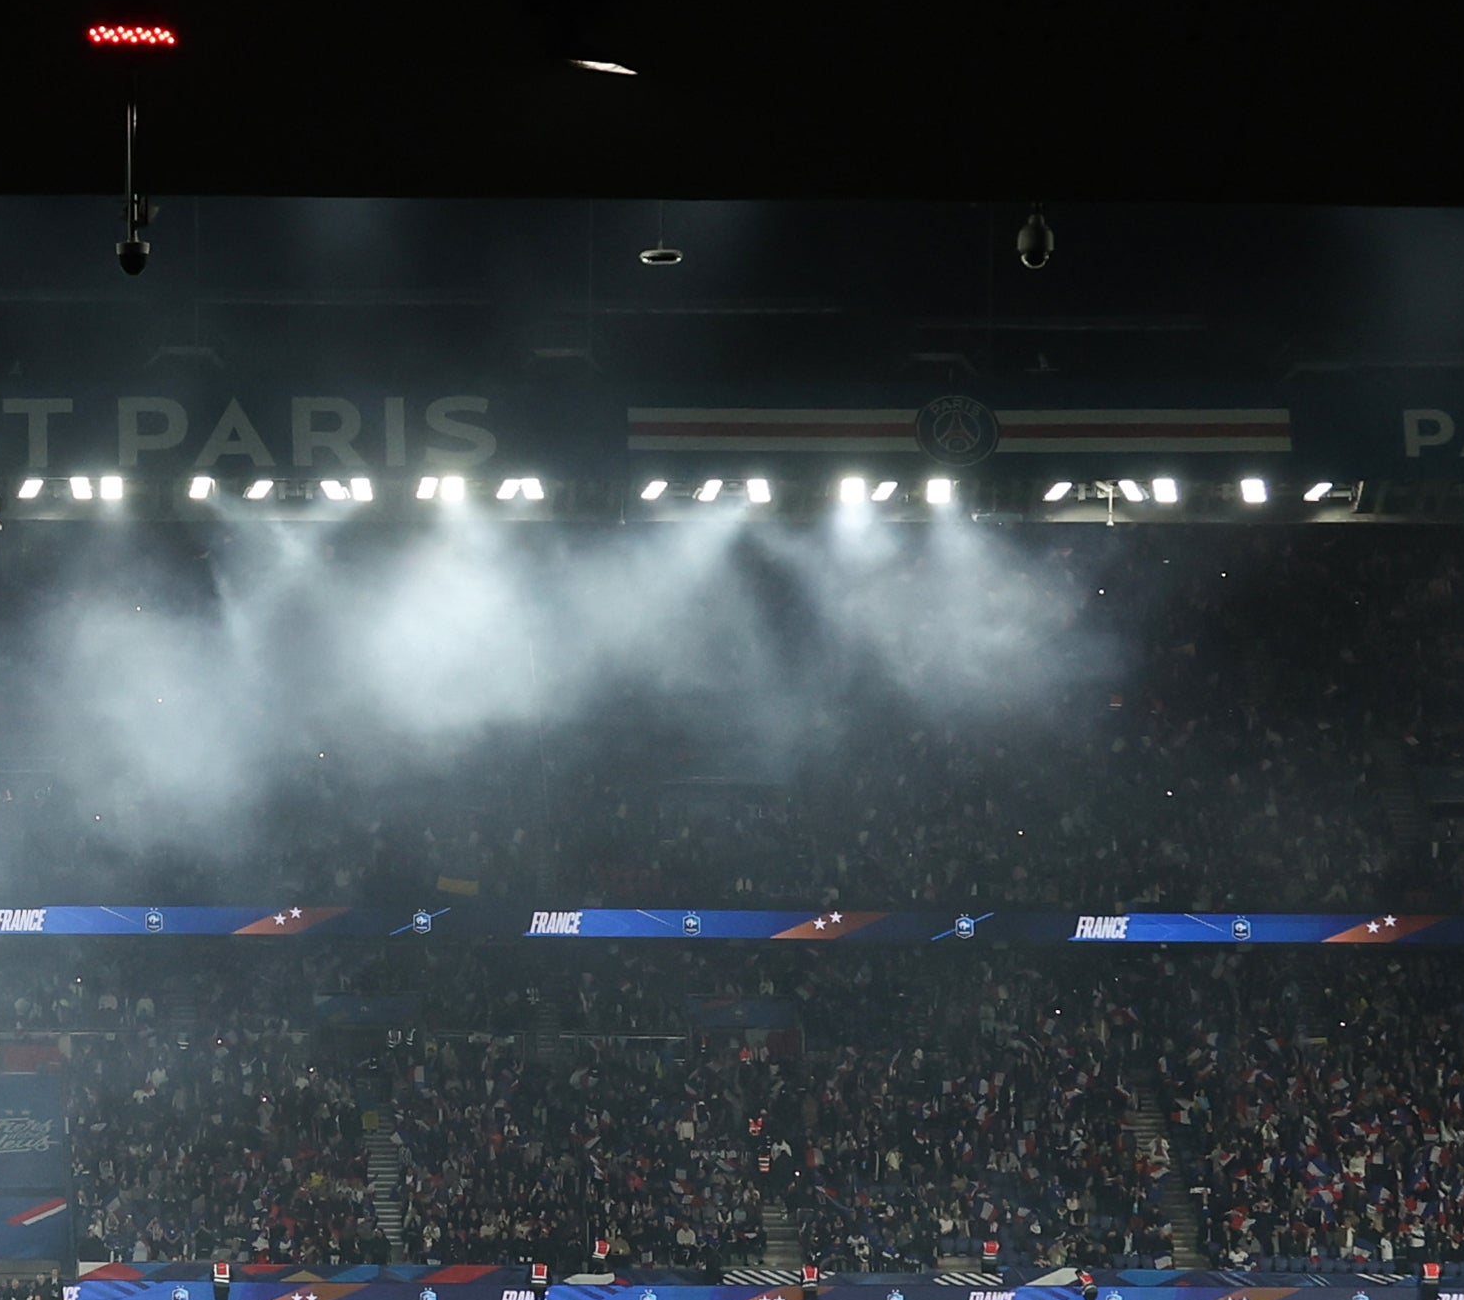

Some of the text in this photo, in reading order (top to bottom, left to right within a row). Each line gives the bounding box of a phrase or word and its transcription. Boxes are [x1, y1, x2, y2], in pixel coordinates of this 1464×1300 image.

[117, 396, 496, 469] PARIS
[530, 912, 582, 934] FRANCE
[1075, 916, 1129, 940] FRANCE
